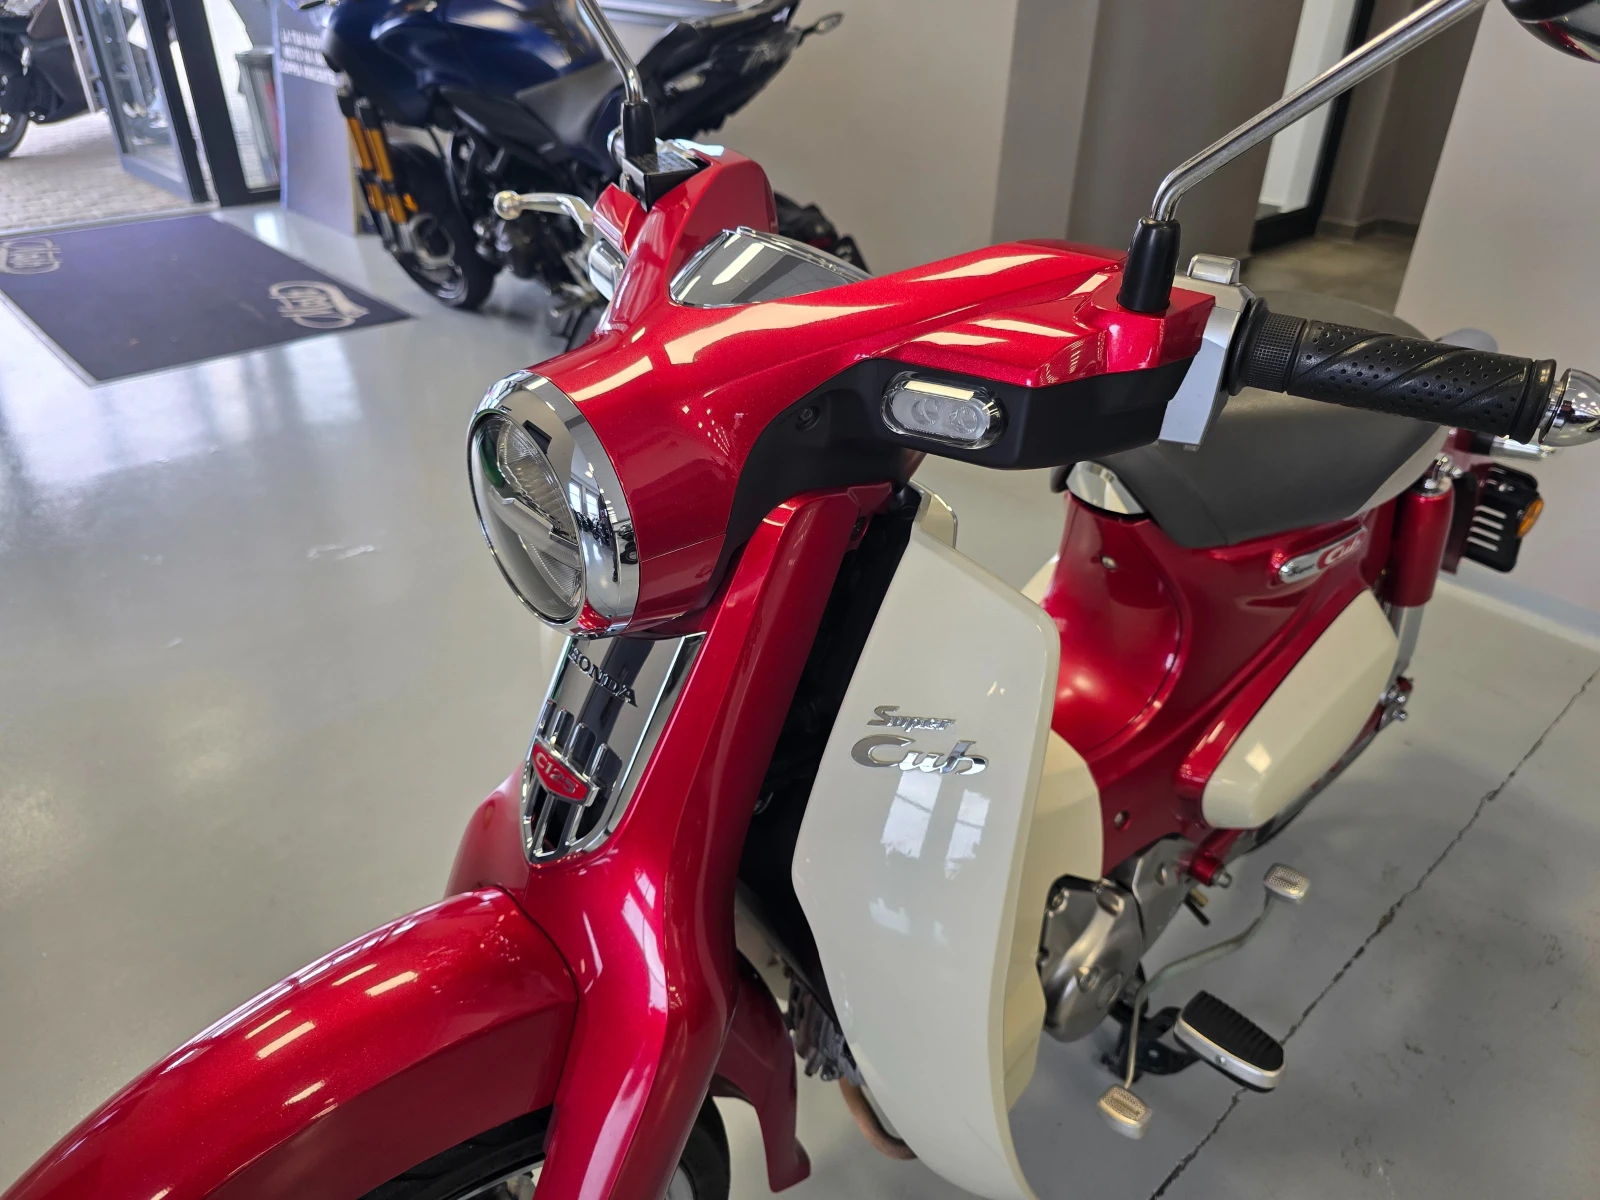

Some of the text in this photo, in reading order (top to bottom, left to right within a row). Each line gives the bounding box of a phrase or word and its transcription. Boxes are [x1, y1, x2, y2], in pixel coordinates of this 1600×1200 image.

[568, 645, 638, 708] HONDA
[867, 705, 956, 733] Super
[535, 752, 579, 794] C125
[851, 734, 989, 775] Cub
